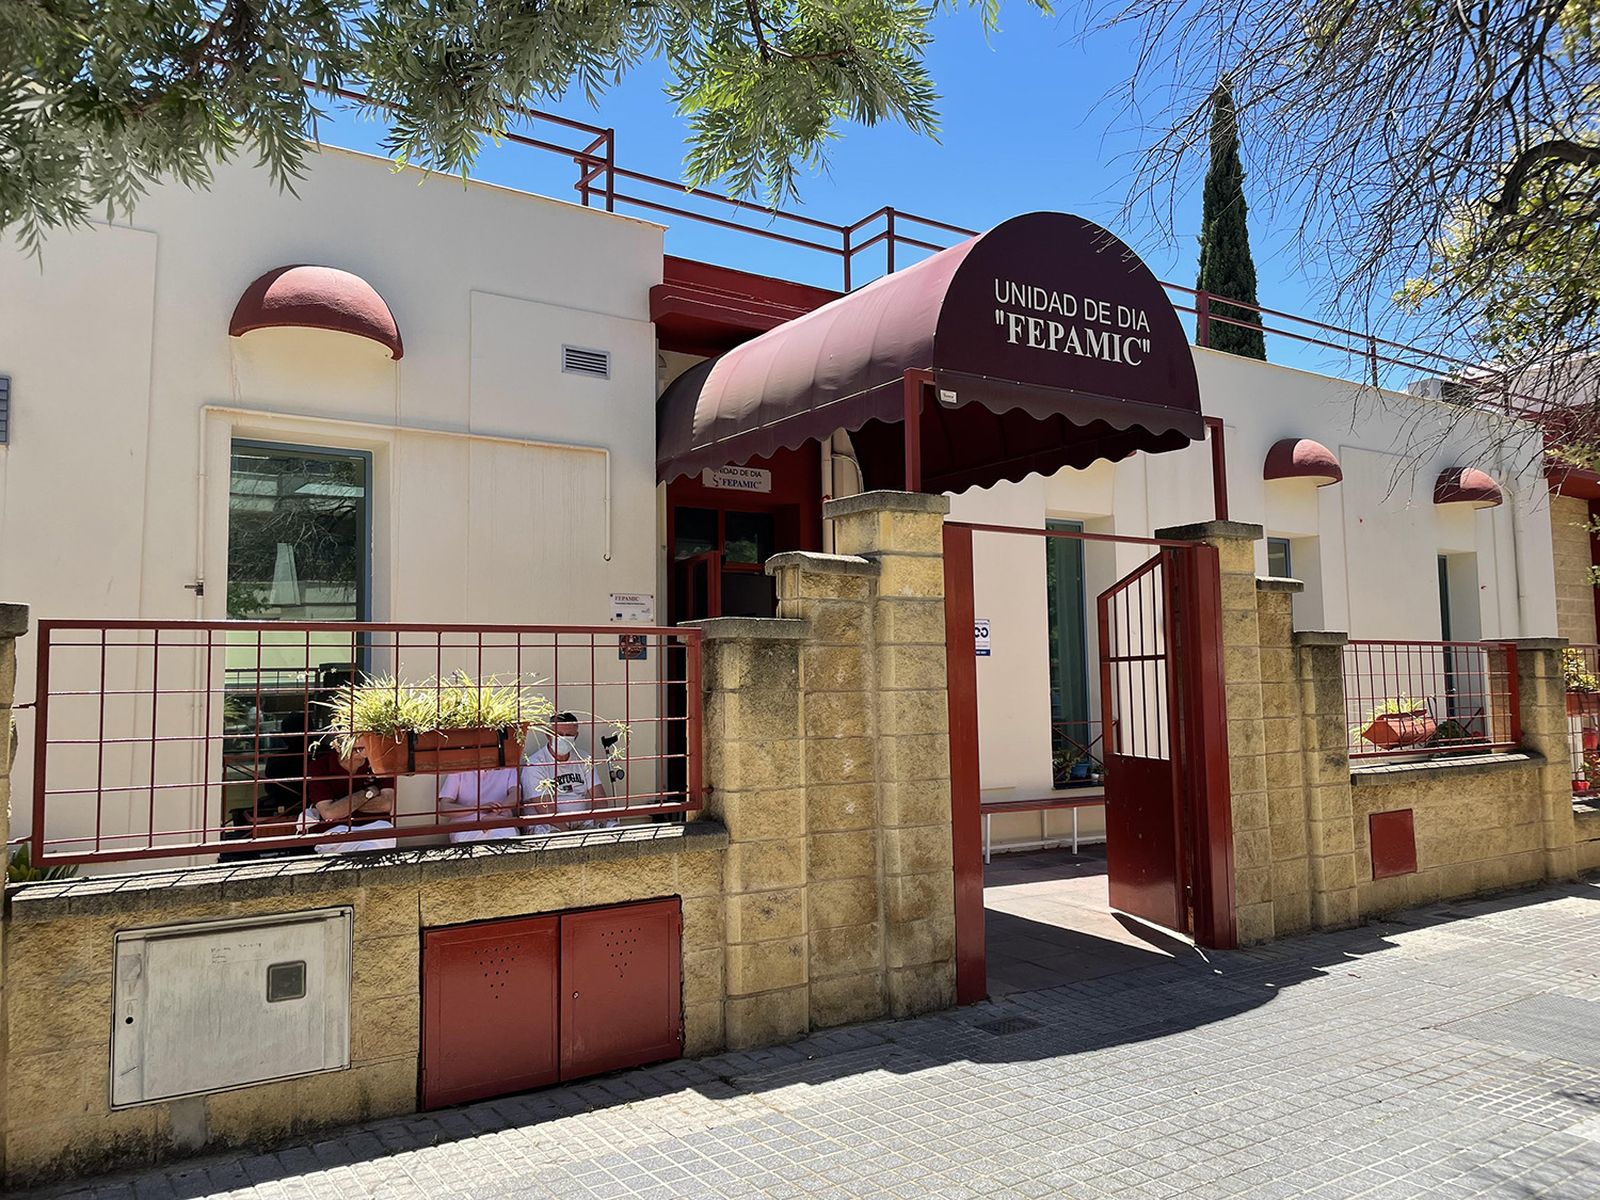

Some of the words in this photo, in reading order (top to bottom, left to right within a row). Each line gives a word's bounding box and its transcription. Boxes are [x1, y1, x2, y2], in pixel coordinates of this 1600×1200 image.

[995, 278, 1078, 317] UNIDAD
[1084, 298, 1112, 325] DE
[1117, 305, 1151, 333] DIA
[994, 309, 1151, 367] "FEPAMIC"
